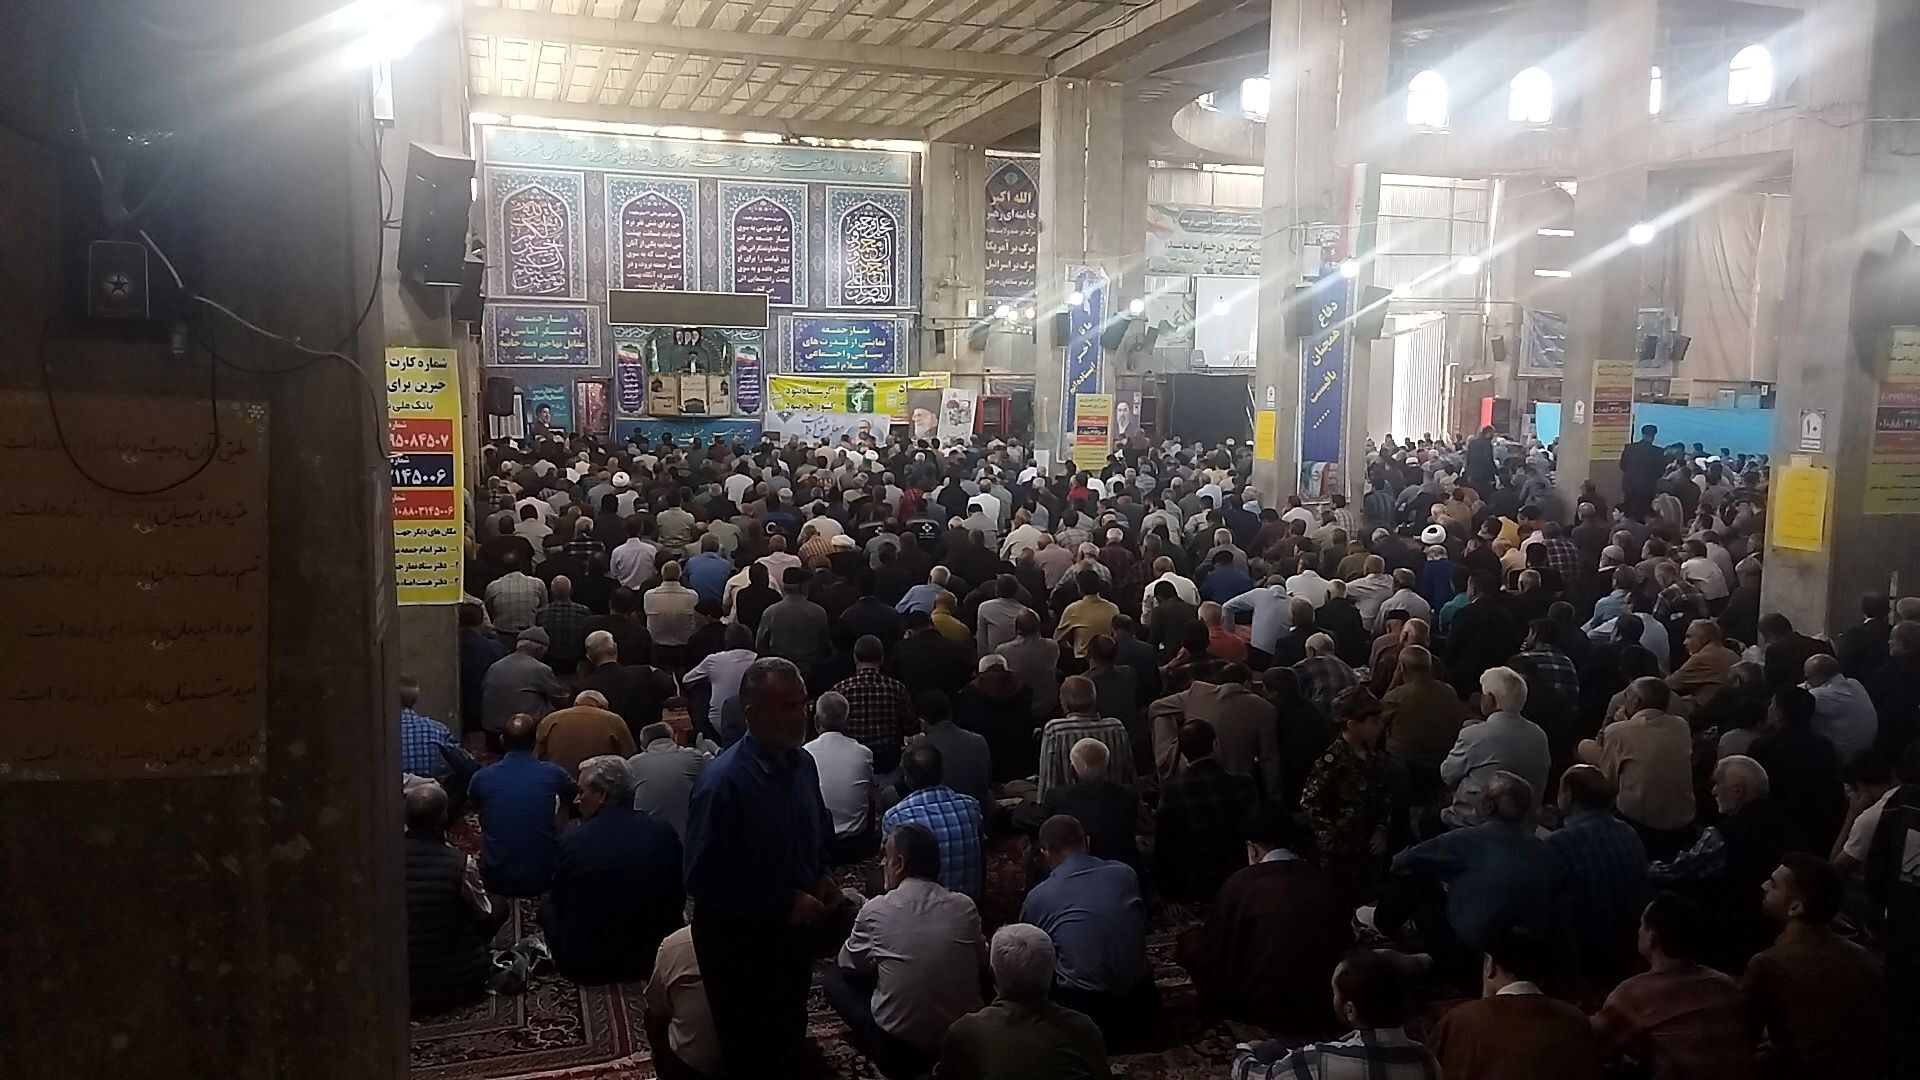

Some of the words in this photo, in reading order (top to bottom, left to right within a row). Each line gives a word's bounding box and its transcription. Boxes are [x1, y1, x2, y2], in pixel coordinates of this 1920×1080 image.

[989, 189, 1012, 206] اکبر
[1014, 191, 1032, 204] الله
[985, 238, 1009, 254] آمریکا
[1009, 244, 1018, 255] بر
[1018, 242, 1036, 255] مرگ
[1011, 261, 1020, 272] بر
[1019, 260, 1035, 273] مرگ
[515, 314, 544, 323] جمعه
[546, 313, 568, 325] نماز
[1318, 301, 1339, 329] دفاع
[820, 325, 848, 334] جمعه
[849, 325, 871, 336] نماز
[820, 337, 849, 348] قدرت
[849, 338, 858, 349] از
[1311, 328, 1341, 367] همچنان
[804, 349, 845, 359] اجتماعی
[851, 349, 884, 360] سیاسی
[389, 355, 416, 371] کارت
[417, 357, 448, 372] شماره
[840, 361, 868, 371] اسلام
[387, 377, 411, 393] برای
[414, 378, 446, 394] خیرین
[1309, 368, 1338, 403] باقیست
[392, 401, 411, 412] ملی
[410, 400, 434, 412] بانک
[392, 492, 406, 503] شمار
[413, 528, 428, 537] دیگر
[418, 546, 432, 554] امام
[433, 546, 447, 555] دفتر
[433, 562, 447, 572] دفتر
